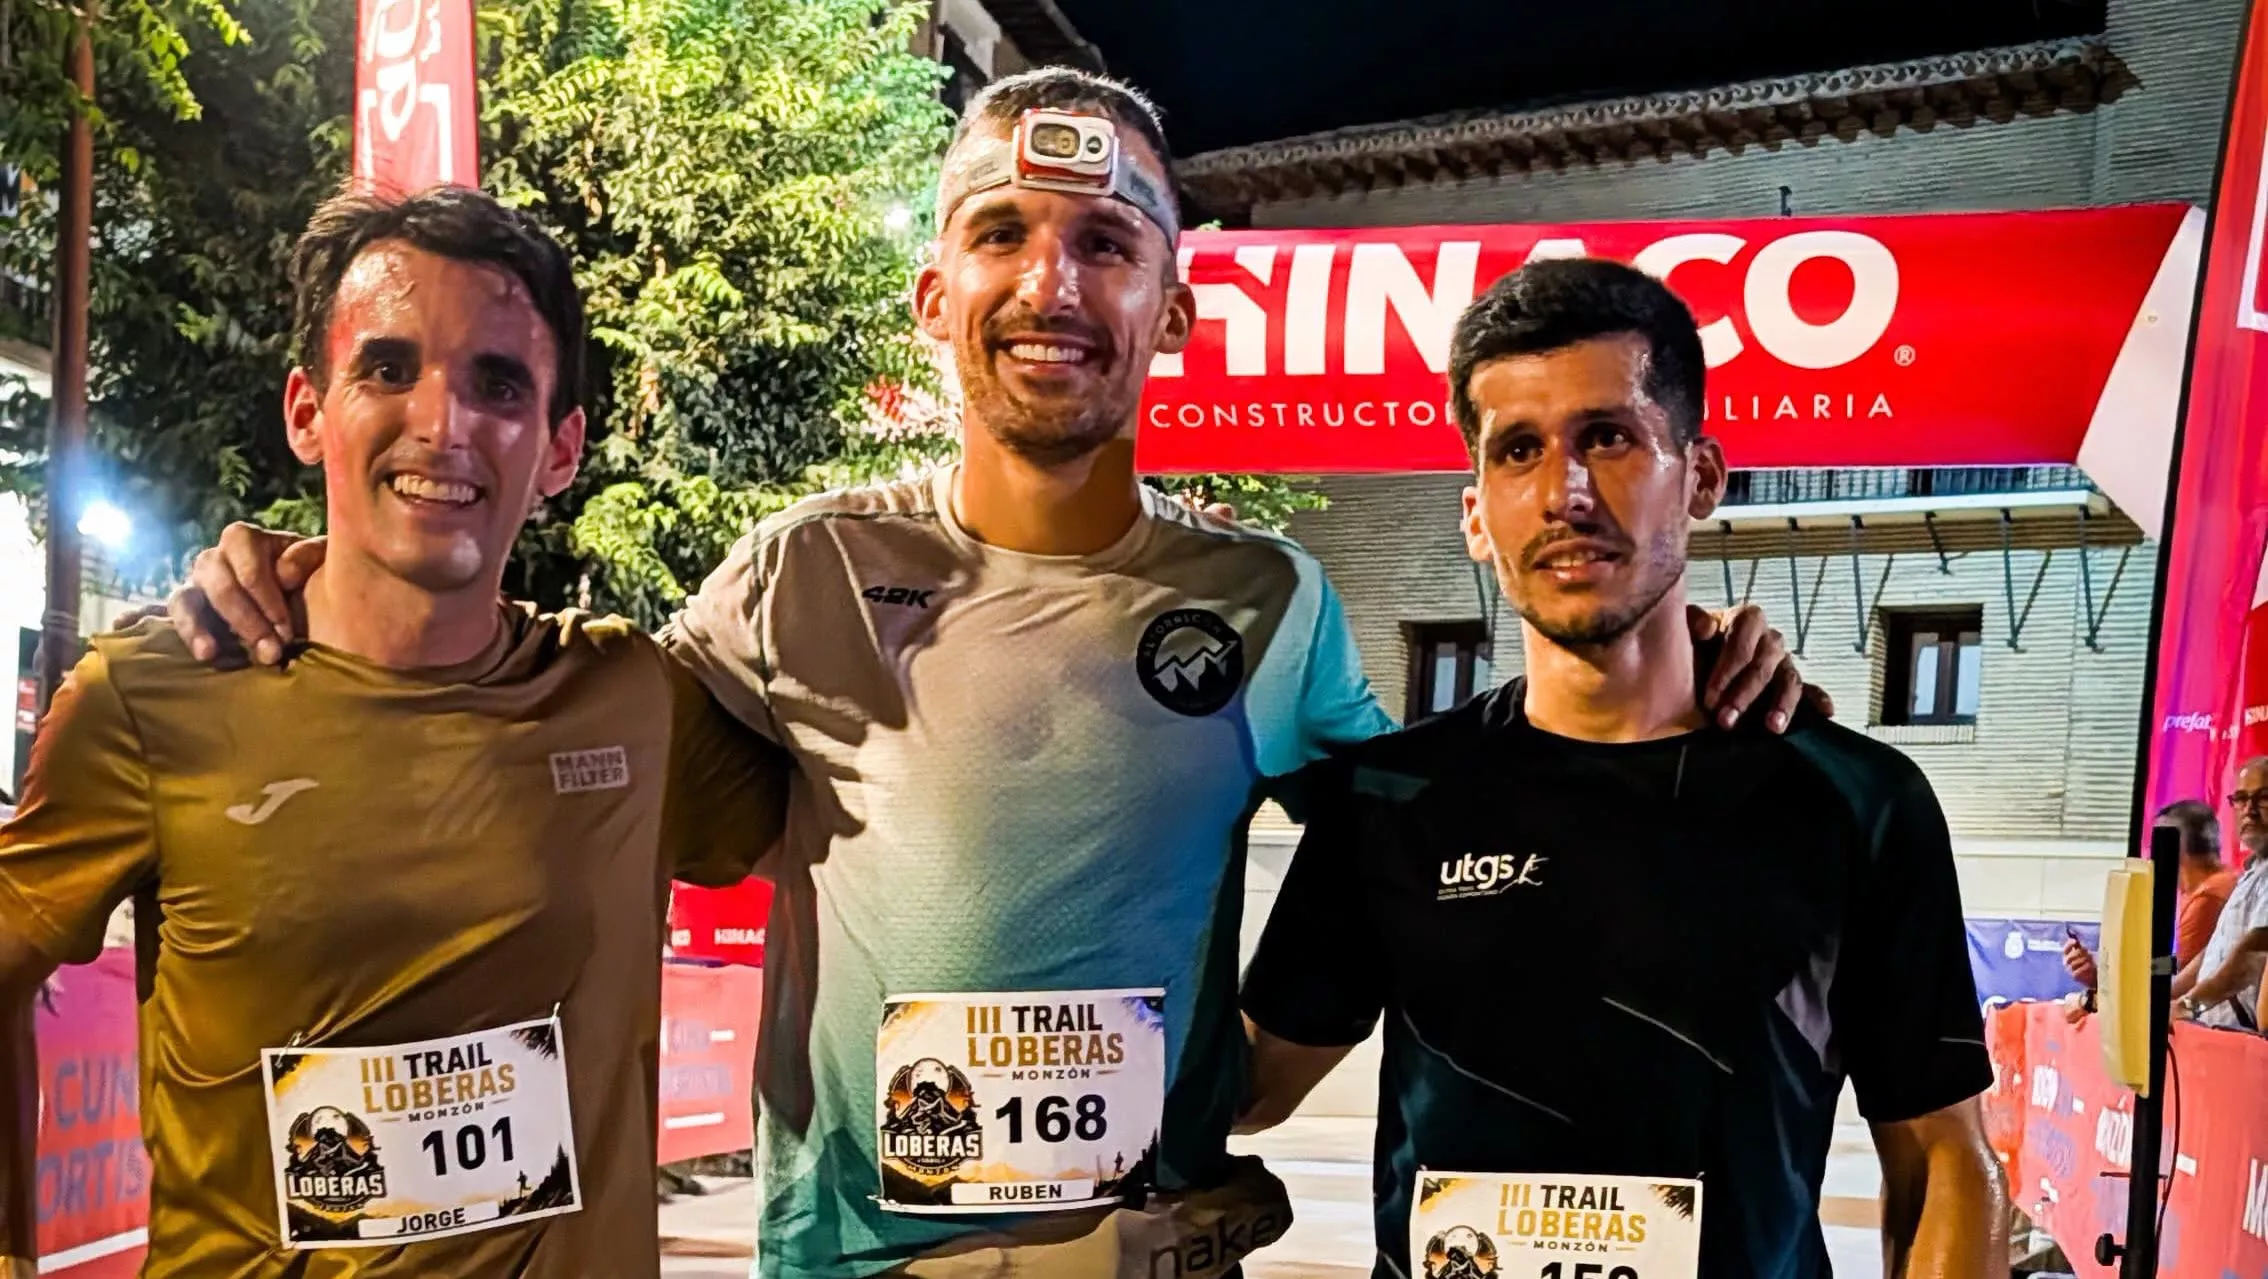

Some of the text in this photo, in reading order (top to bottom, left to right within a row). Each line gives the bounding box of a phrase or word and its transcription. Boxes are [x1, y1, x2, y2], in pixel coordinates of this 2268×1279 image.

[1149, 230, 1900, 377] HINCO
[862, 585, 935, 609] 42K
[554, 751, 623, 771] MANN
[559, 766, 625, 789] FILTER
[1440, 852, 1515, 890] utgs
[1011, 1003, 1103, 1033] TRAIL
[403, 1042, 493, 1079] TRAIL
[967, 1032, 1124, 1067] LOBERAS
[1012, 1067, 1091, 1081] MONZÓN
[363, 1063, 516, 1114] LOBERAS
[408, 1101, 485, 1122] MONZÓN
[995, 1094, 1108, 1144] 168
[422, 1116, 514, 1177] 101
[883, 1133, 981, 1158] LOBERAS
[288, 1173, 385, 1199] LOBERAS
[989, 1183, 1062, 1201] RUBEN
[1540, 1184, 1626, 1211] TRAIL
[396, 1207, 466, 1234] JORGE
[1496, 1208, 1648, 1244] LOBERAS
[1533, 1239, 1609, 1253] MONZÓN
